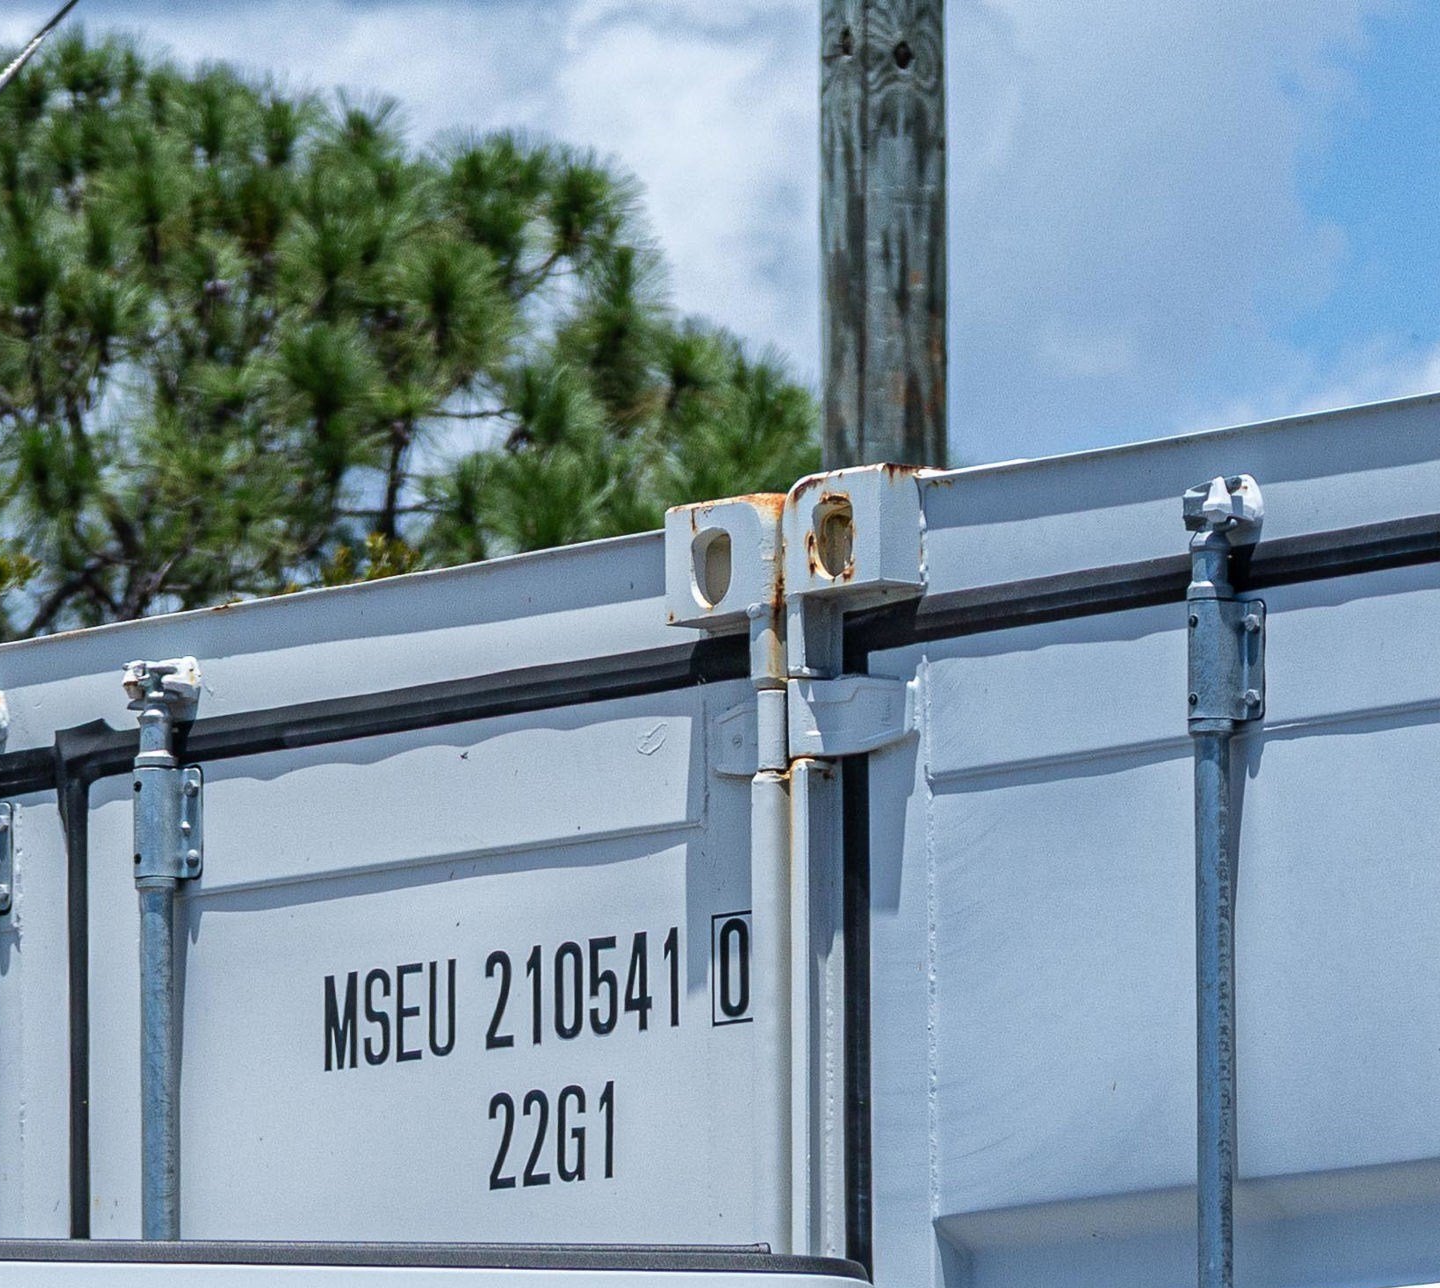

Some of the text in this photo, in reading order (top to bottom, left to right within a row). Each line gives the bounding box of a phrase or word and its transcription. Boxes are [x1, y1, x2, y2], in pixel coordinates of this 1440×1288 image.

[324, 958, 456, 1071] MSEU
[484, 926, 680, 1050] 210541
[488, 1080, 615, 1191] 22G1
